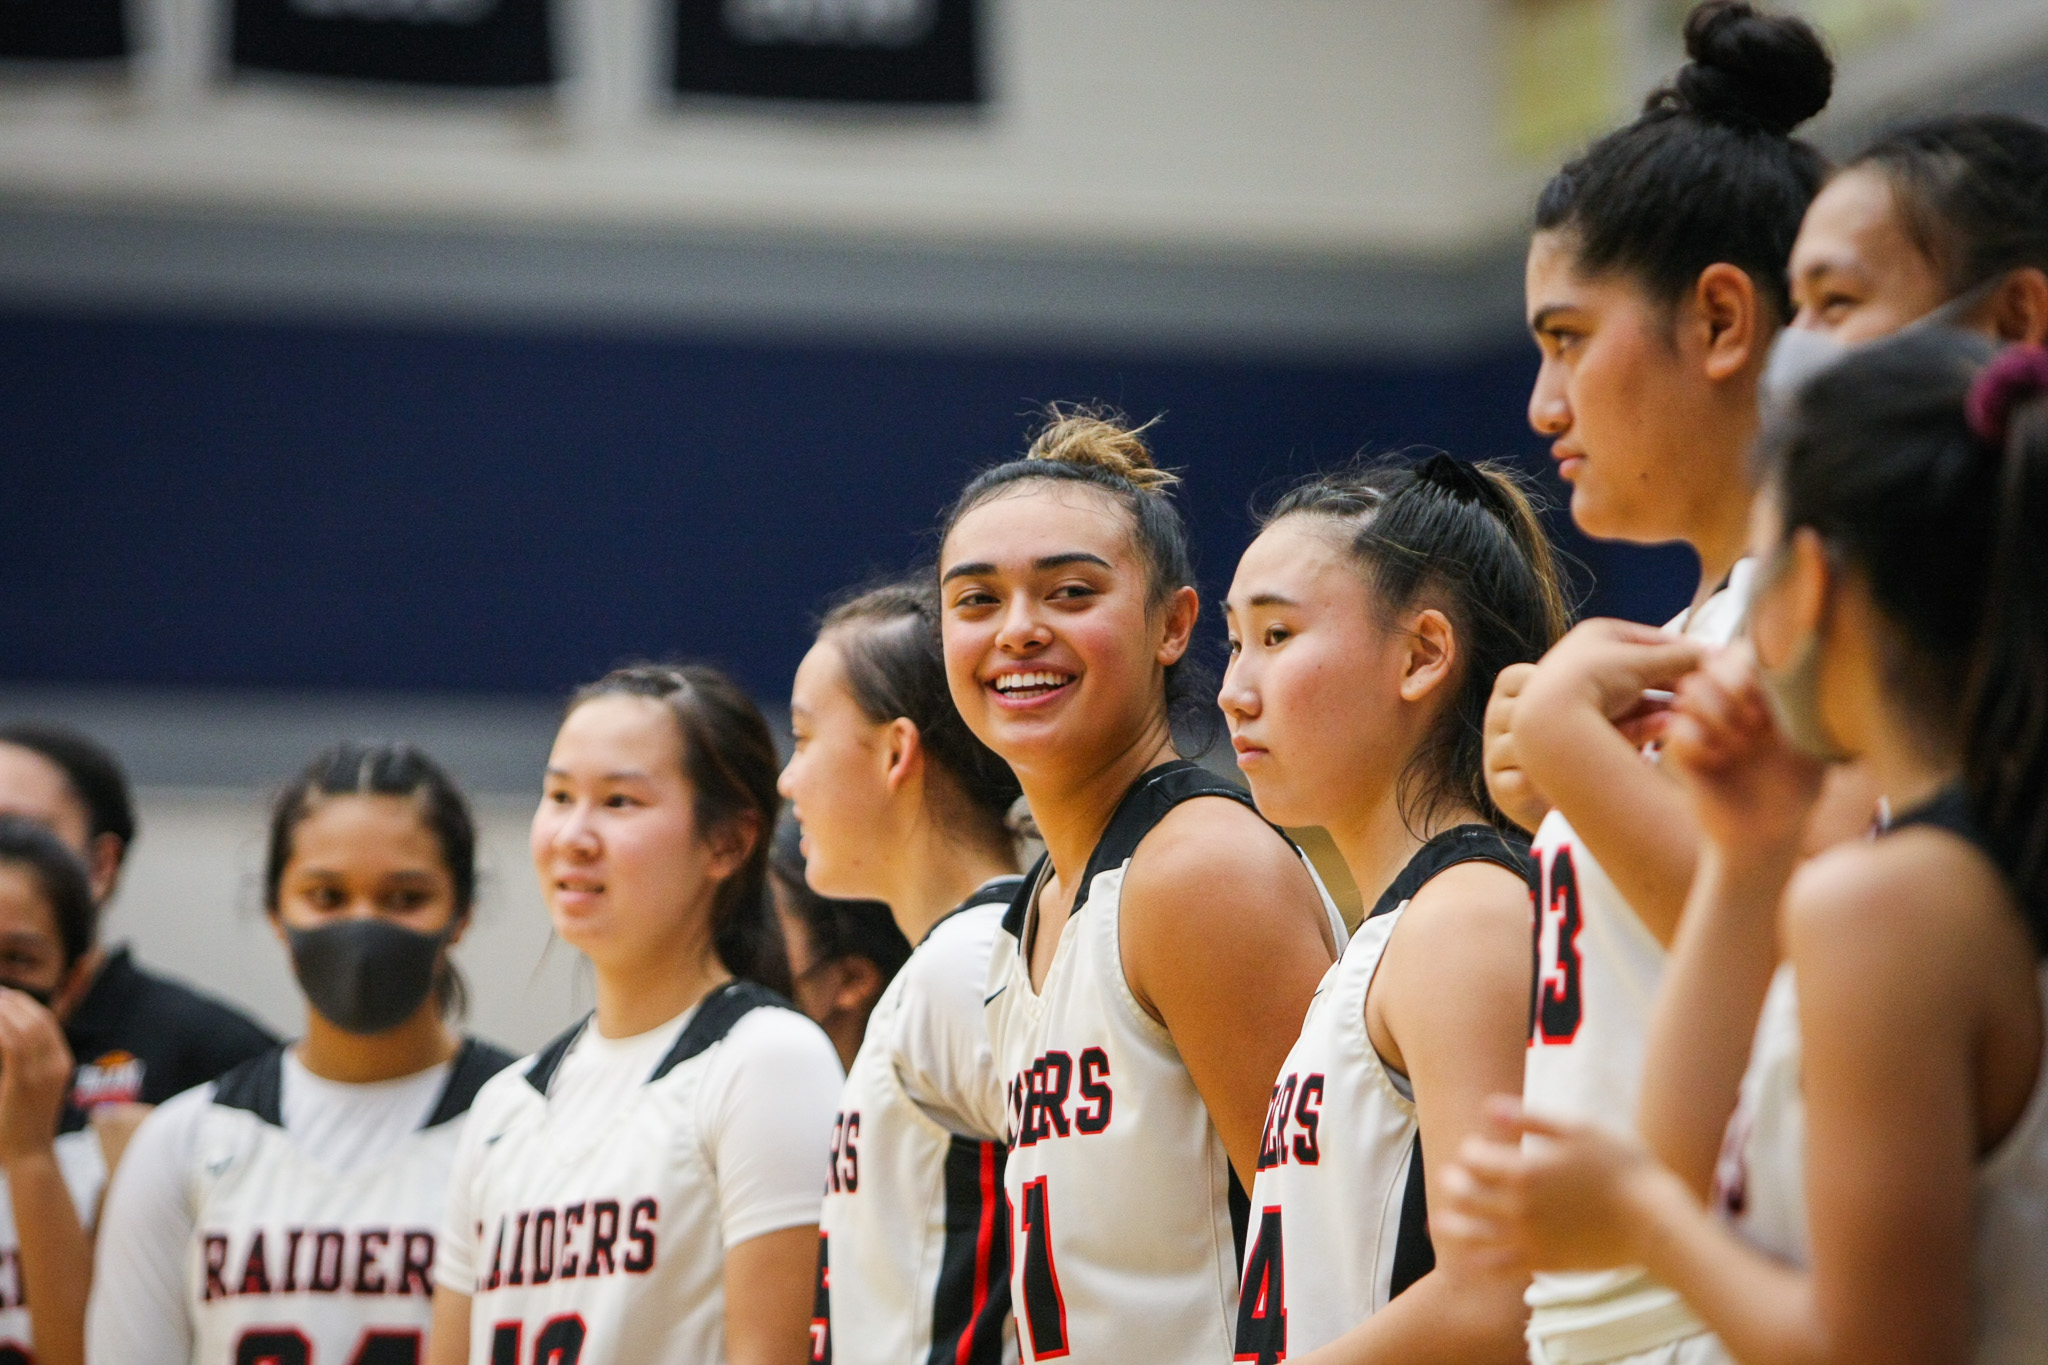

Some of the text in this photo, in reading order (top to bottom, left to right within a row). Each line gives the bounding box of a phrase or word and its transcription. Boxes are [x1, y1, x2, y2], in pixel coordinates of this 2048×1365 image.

[1529, 844, 1583, 1044] 3
[824, 1110, 861, 1195] RS
[1004, 1175, 1070, 1365] 1
